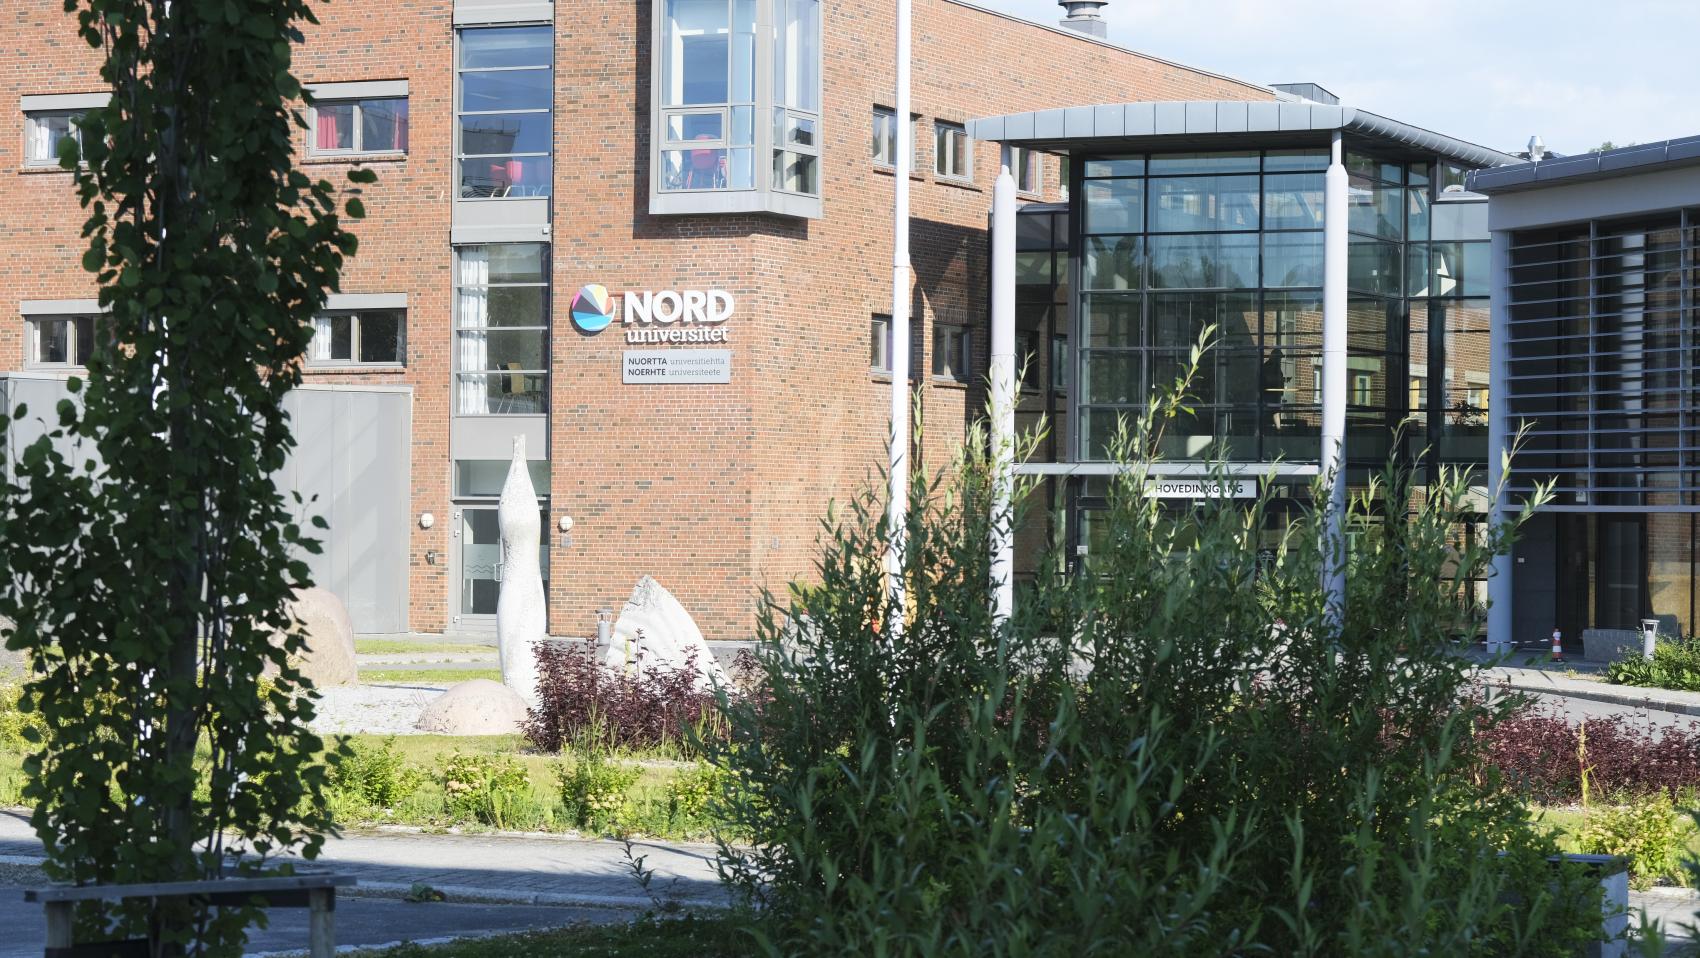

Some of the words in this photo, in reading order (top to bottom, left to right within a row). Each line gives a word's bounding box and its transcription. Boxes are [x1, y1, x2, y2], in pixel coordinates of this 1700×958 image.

[624, 289, 735, 323] NORD
[626, 325, 729, 343] universitet
[628, 357, 667, 365] NUORTTA
[628, 368, 666, 376] NOERHTE
[1156, 484, 1244, 494] HOVEDINNGNG
